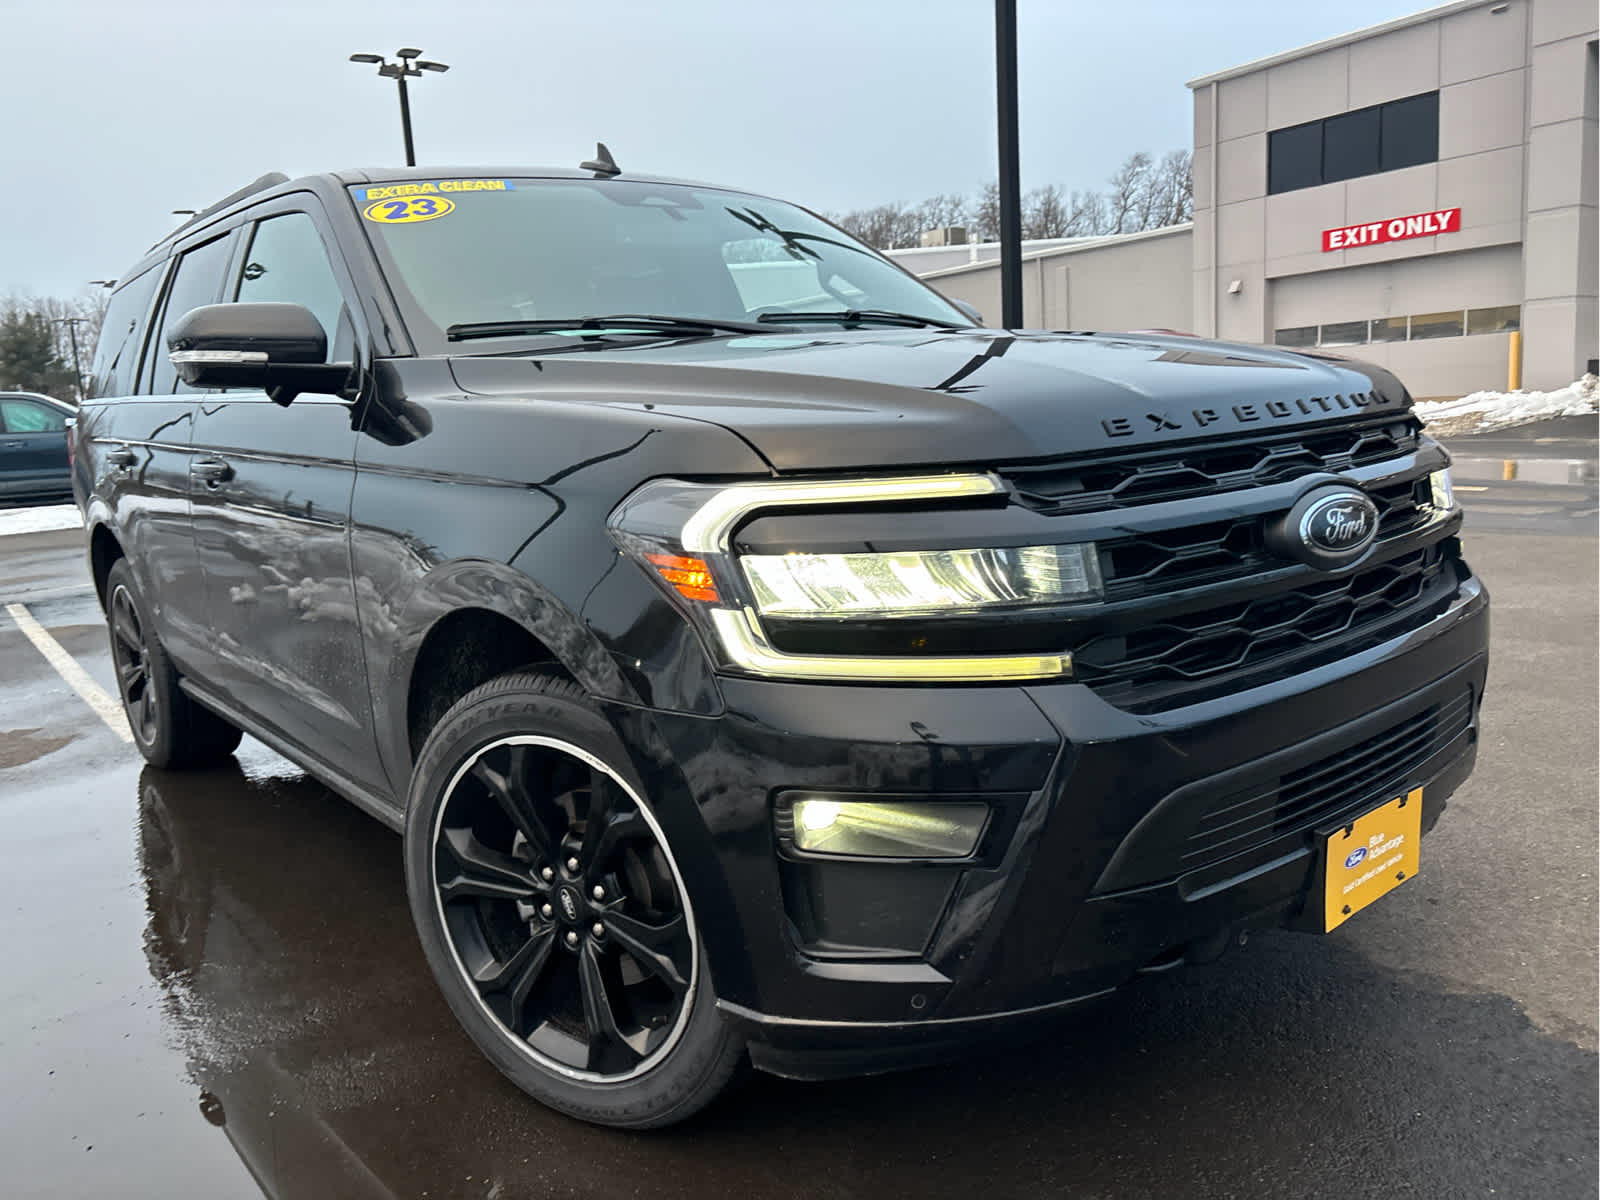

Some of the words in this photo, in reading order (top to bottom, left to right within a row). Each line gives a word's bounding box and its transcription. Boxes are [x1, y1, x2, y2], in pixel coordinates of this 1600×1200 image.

[366, 183, 439, 200] EXTRA
[439, 180, 506, 192] CLEAN
[383, 198, 438, 220] 23
[1329, 223, 1383, 249] EXIT
[1388, 210, 1453, 239] ONLY
[1100, 389, 1390, 438] EXPEDITION
[1326, 506, 1367, 544] Ford
